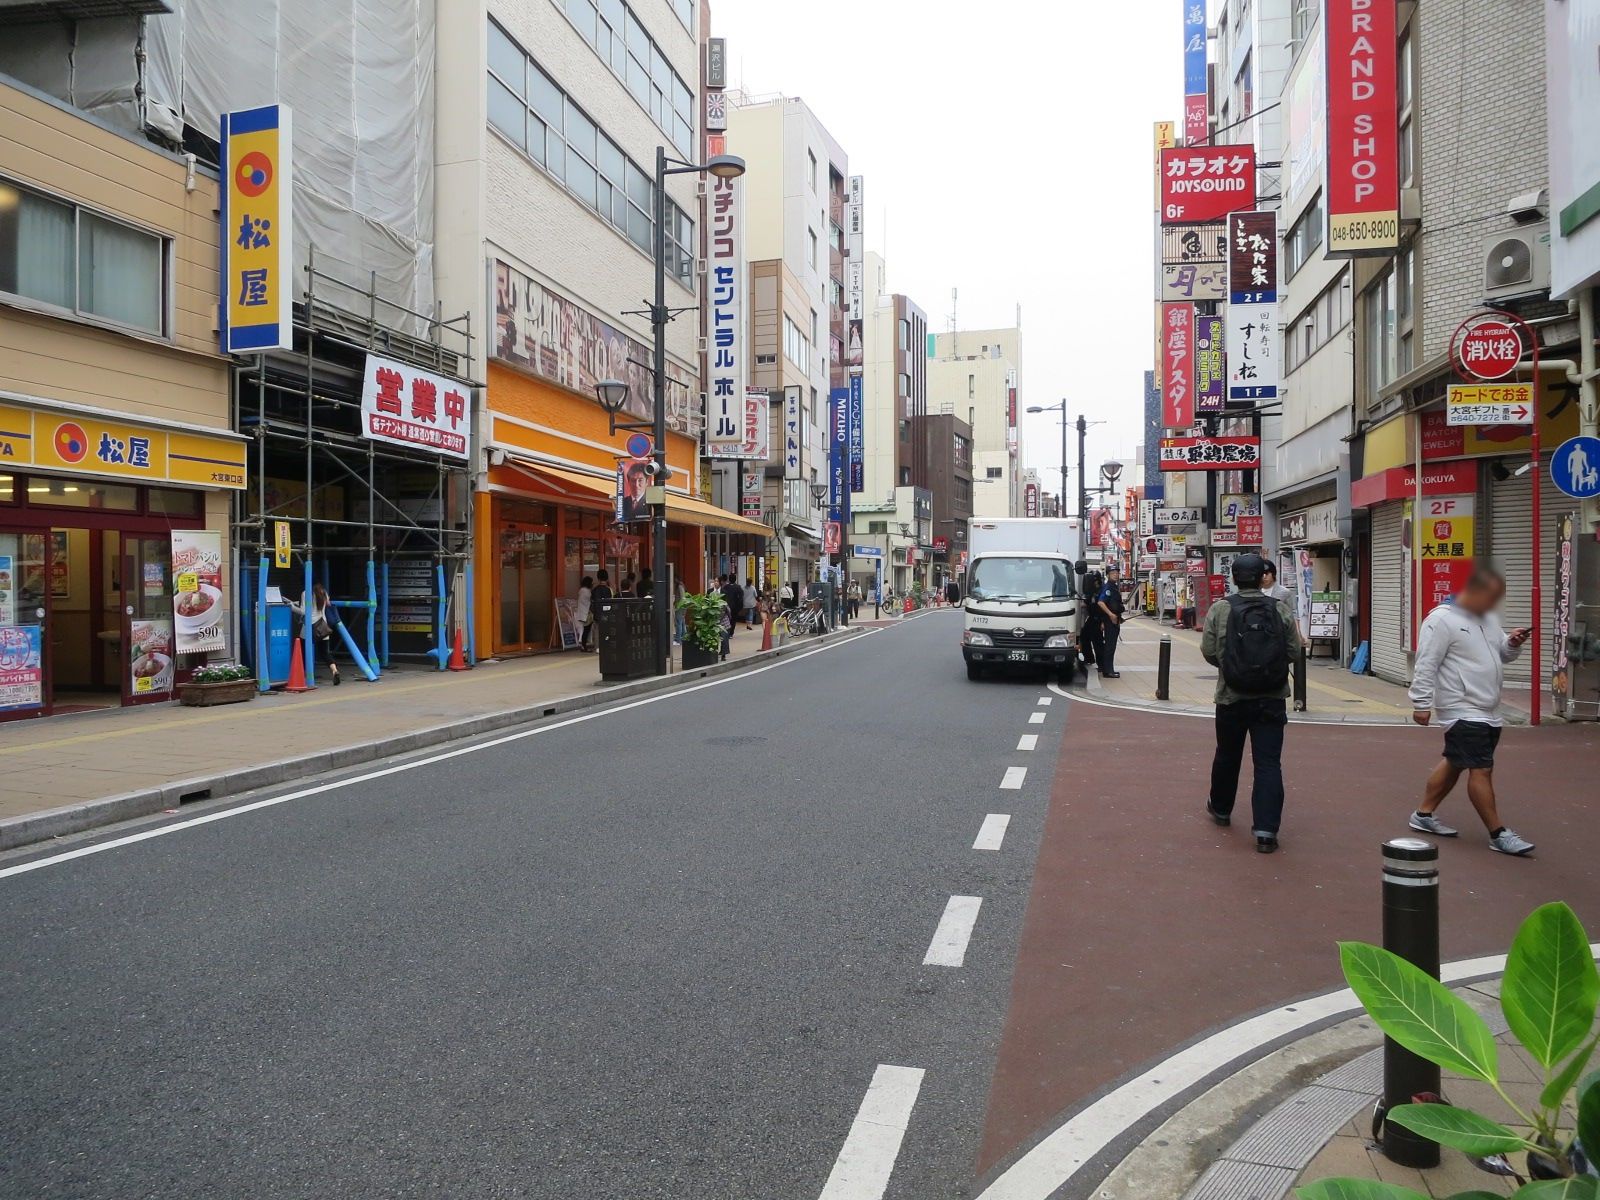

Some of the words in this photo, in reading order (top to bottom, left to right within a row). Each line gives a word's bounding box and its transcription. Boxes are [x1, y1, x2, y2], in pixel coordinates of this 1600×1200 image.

[1167, 155, 1249, 177] カラオケ
[1351, 115, 1377, 203] SHOP
[1170, 178, 1246, 193] JOYSOUND
[1166, 204, 1185, 219] 6F
[1236, 219, 1248, 253] とんかつ
[1333, 220, 1396, 241] 048-650-8900
[236, 213, 271, 307] 松屋
[1248, 234, 1272, 286] 松乃家
[1244, 293, 1263, 303] 2F
[714, 266, 735, 369] セントラル
[1259, 312, 1271, 358] 回転寿司
[1210, 321, 1221, 380] ネットカフェ
[1238, 323, 1258, 380] すし松
[1466, 338, 1516, 361] 消火栓
[1167, 307, 1188, 423] 銀座アスター
[1199, 350, 1210, 392] コミック
[375, 366, 465, 430] 営業中
[1245, 388, 1263, 397] 1F
[1450, 387, 1529, 402] カードでお金
[714, 377, 736, 437] ホール
[1201, 395, 1219, 406] 24H
[1450, 405, 1499, 415] 大宮ギフト
[837, 398, 847, 442] MIZUHO
[1457, 414, 1500, 422] 640-7272
[743, 400, 759, 452] カラオケ
[1423, 428, 1459, 438] WATCH
[0, 441, 14, 456] A
[97, 432, 150, 467] 松屋
[787, 421, 798, 467] てんや
[1163, 439, 1175, 448] 1F
[1423, 440, 1461, 450] EWELRY
[210, 472, 243, 484] 大宮東口店
[1404, 474, 1456, 486] DAKOKUYA
[1431, 501, 1456, 514] 2F
[1241, 533, 1263, 541] アスター
[1435, 523, 1450, 537] 質
[1421, 542, 1465, 557] 大黒屋
[174, 551, 219, 564] トマトバジル
[972, 616, 989, 624] A1172
[199, 626, 218, 639] 590
[1011, 653, 1027, 661] 55-21
